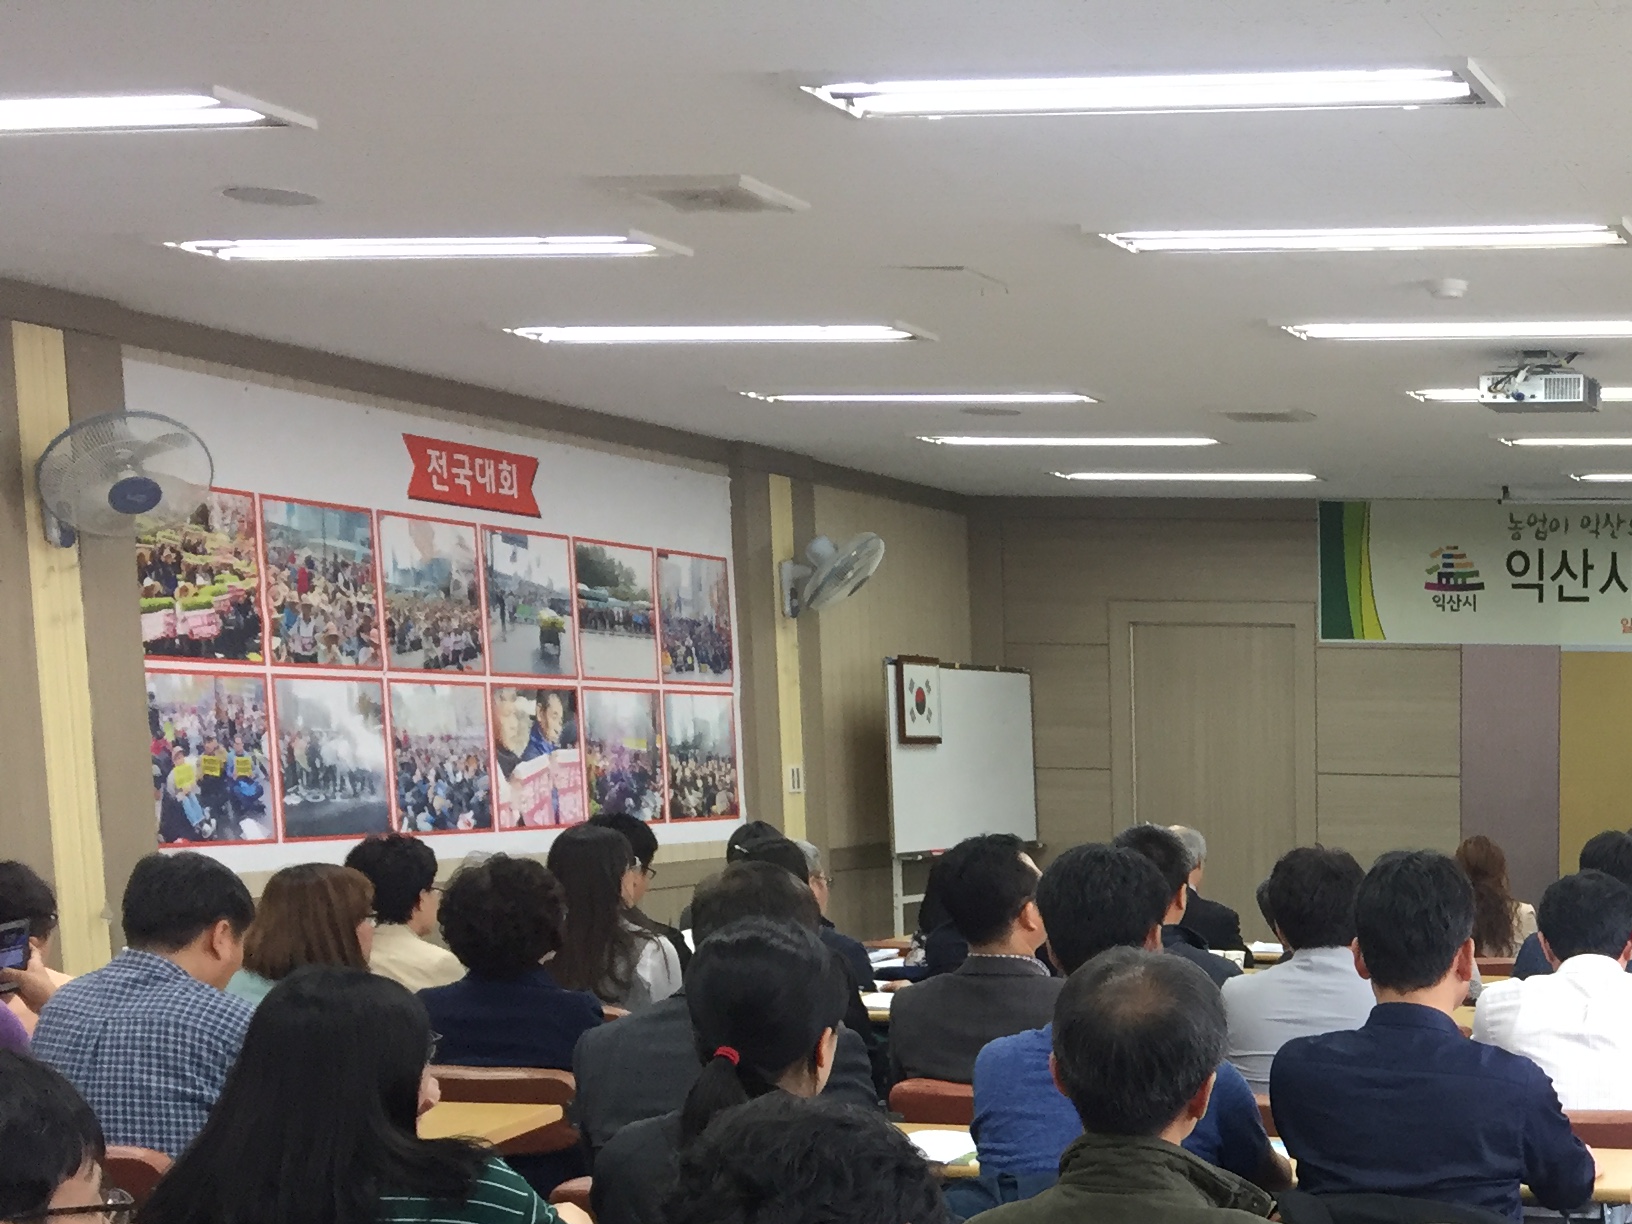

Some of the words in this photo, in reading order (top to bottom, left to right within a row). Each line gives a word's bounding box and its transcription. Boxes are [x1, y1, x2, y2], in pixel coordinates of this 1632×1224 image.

[426, 448, 519, 499] 전국대회
[1507, 512, 1570, 542] 농업이
[1431, 593, 1477, 613] 익산시
